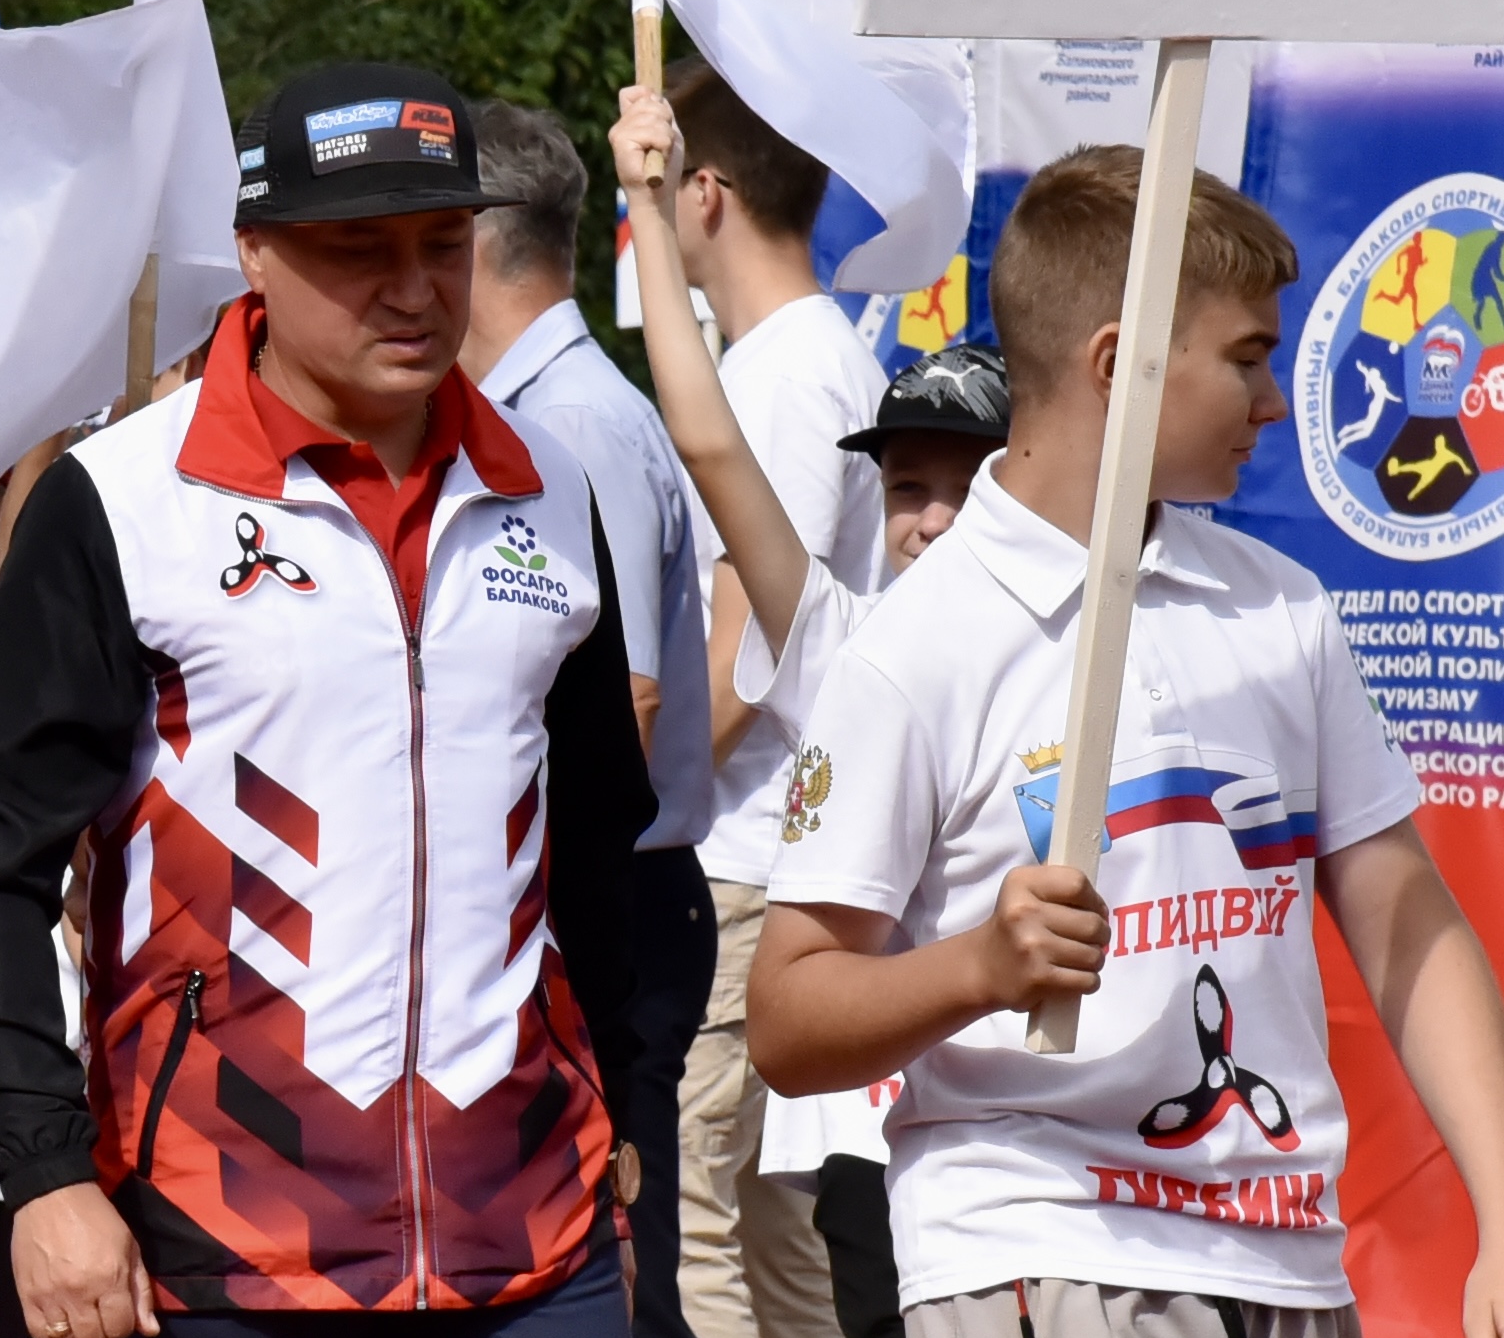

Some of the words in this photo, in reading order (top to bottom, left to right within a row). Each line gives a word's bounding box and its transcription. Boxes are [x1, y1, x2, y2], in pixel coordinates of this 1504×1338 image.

[316, 143, 367, 163] BAKERY
[1337, 201, 1426, 298] БАЛАКОВО
[481, 566, 568, 598] ФОСАГРО
[486, 587, 571, 617] БАЛАКОВО
[1389, 590, 1420, 614] ПО
[1354, 650, 1432, 679] ЖНОЙ
[1104, 874, 1300, 958] ПИДВЙ
[1086, 1165, 1328, 1229] ТУРБИНА
